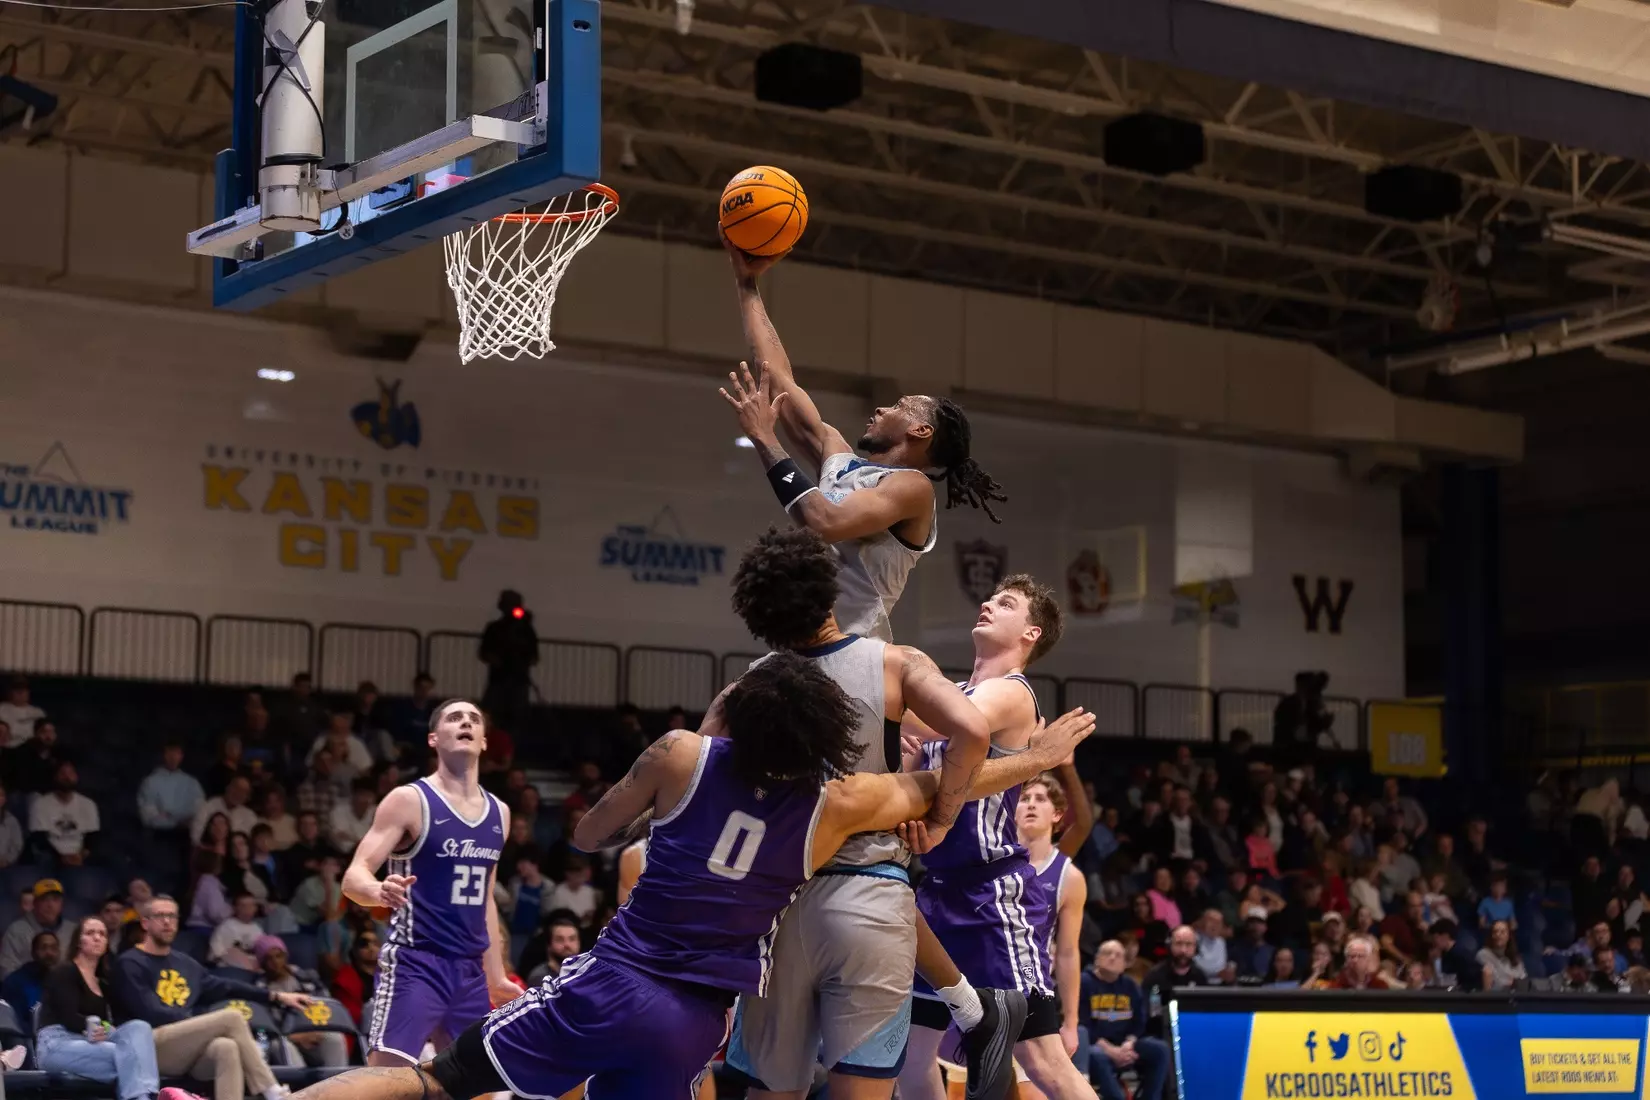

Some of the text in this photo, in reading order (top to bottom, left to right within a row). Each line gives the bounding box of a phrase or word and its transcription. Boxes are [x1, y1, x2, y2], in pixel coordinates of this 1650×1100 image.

[722, 191, 754, 217] NCAA
[0, 481, 134, 521] UMMIT
[202, 464, 541, 541] KANSAS
[10, 515, 99, 535] LEAGUE
[279, 523, 474, 582] CITY
[600, 536, 726, 576] SUMMIT
[1292, 573, 1355, 635] W
[436, 838, 459, 858] St.
[706, 809, 767, 881] 0
[450, 866, 487, 906] 23
[1532, 1070, 1559, 1083] LATEST
[1561, 1070, 1581, 1083] ROOS
[1583, 1070, 1606, 1083] NEWS
[1548, 1052, 1578, 1065] TICKETS
[1603, 1052, 1616, 1064] ALL
[1618, 1052, 1632, 1064] THE
[1265, 1071, 1453, 1098] KCROOSATHLETICS
